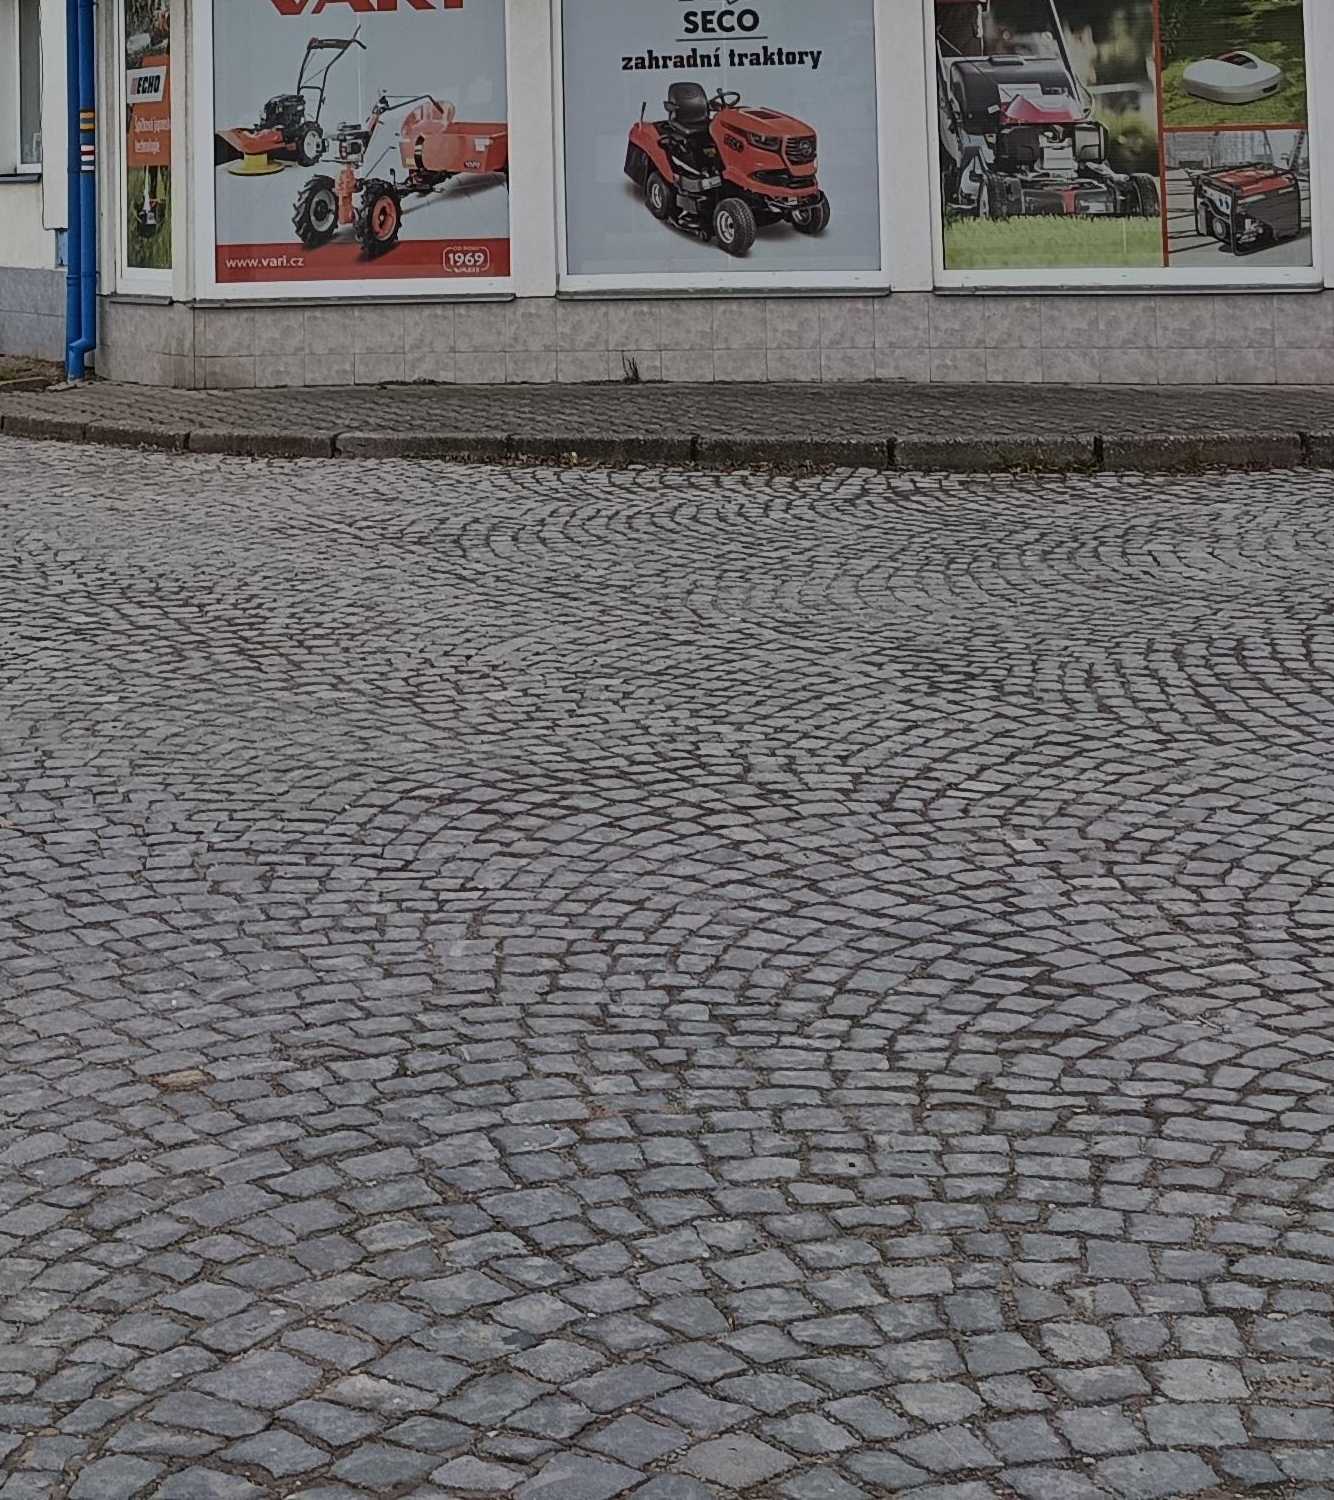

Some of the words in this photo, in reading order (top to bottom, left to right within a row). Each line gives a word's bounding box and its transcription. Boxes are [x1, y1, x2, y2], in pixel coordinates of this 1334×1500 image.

[683, 8, 759, 34] SECO
[621, 46, 721, 71] zahradní
[728, 46, 822, 70] traktory
[137, 75, 161, 95] ECHO
[226, 255, 304, 268] www.vari.cz
[448, 252, 485, 266] 1969
